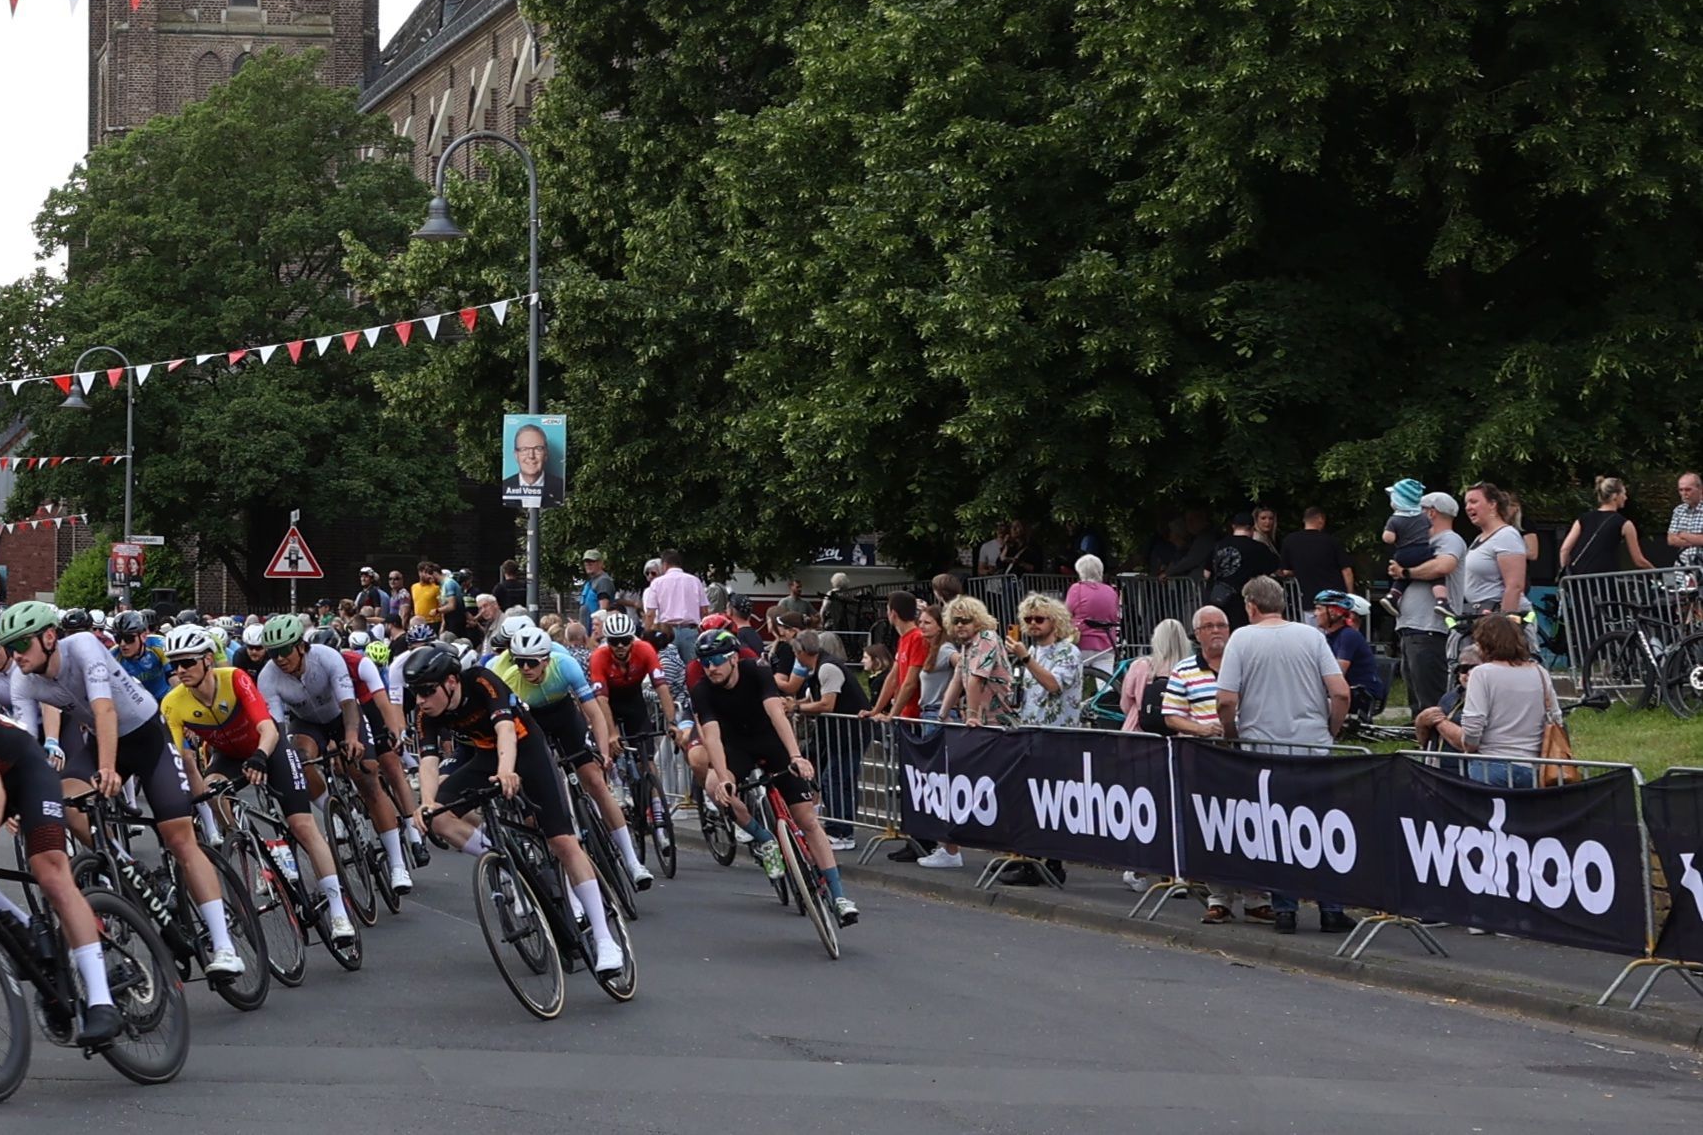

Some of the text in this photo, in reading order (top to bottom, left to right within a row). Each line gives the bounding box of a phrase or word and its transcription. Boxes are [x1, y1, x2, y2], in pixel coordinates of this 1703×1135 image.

[522, 487, 542, 495] Voss
[119, 677, 146, 705] FACTOR
[1027, 751, 1157, 844] wahoo
[1191, 769, 1357, 874] wahoo
[116, 849, 174, 927] FACTOR
[1399, 798, 1615, 915] wahoo
